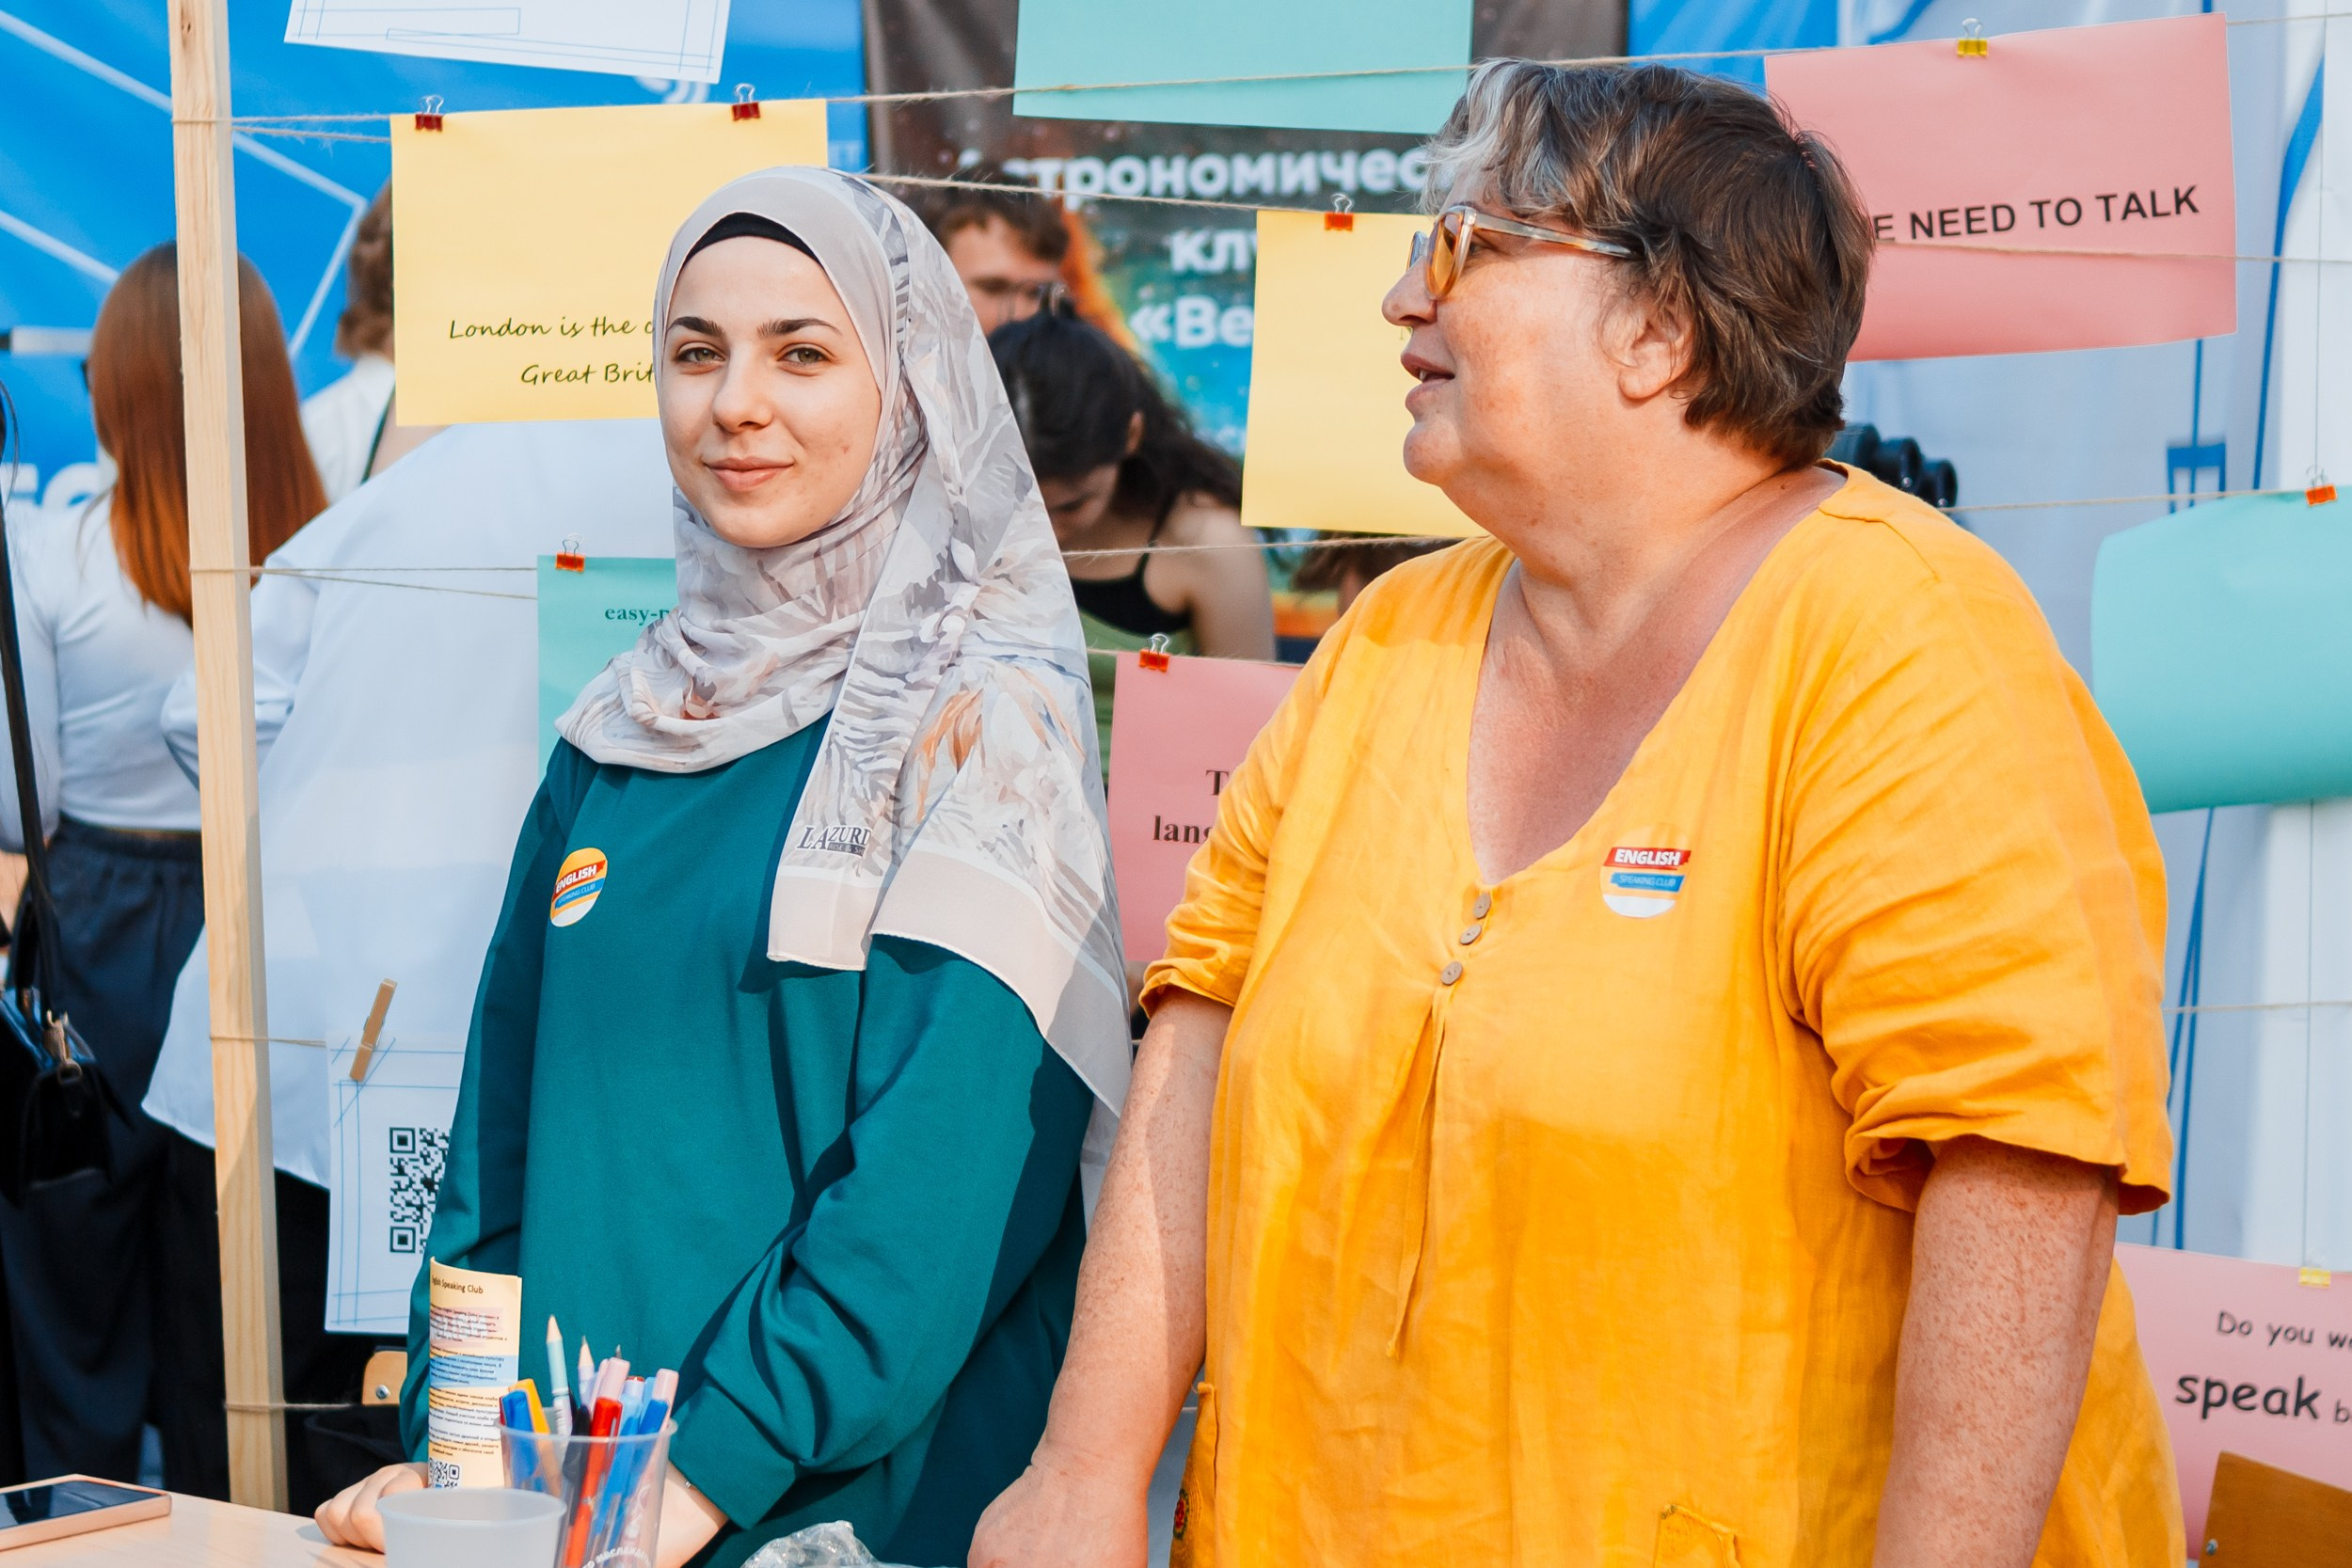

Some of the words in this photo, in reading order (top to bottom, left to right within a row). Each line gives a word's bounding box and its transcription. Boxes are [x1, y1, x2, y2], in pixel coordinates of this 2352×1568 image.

[957, 148, 1428, 210] трономичес
[1910, 203, 2016, 240] NEED
[2029, 198, 2083, 229] TO
[2095, 184, 2200, 223] TALK
[450, 317, 552, 339] London
[560, 316, 585, 338] is
[591, 316, 637, 337] the
[521, 364, 596, 387] Great
[1614, 848, 1681, 865] ENGLISH
[555, 863, 597, 894] ENGLISH
[580, 882, 596, 894] CLUB
[1619, 874, 1655, 886] SPEAKING
[1656, 878, 1677, 887] CLUB
[441, 1279, 467, 1293] Speaking
[467, 1284, 484, 1294] Club
[2217, 1310, 2253, 1337] Do
[2266, 1323, 2314, 1348] you
[2174, 1373, 2322, 1421] speak
